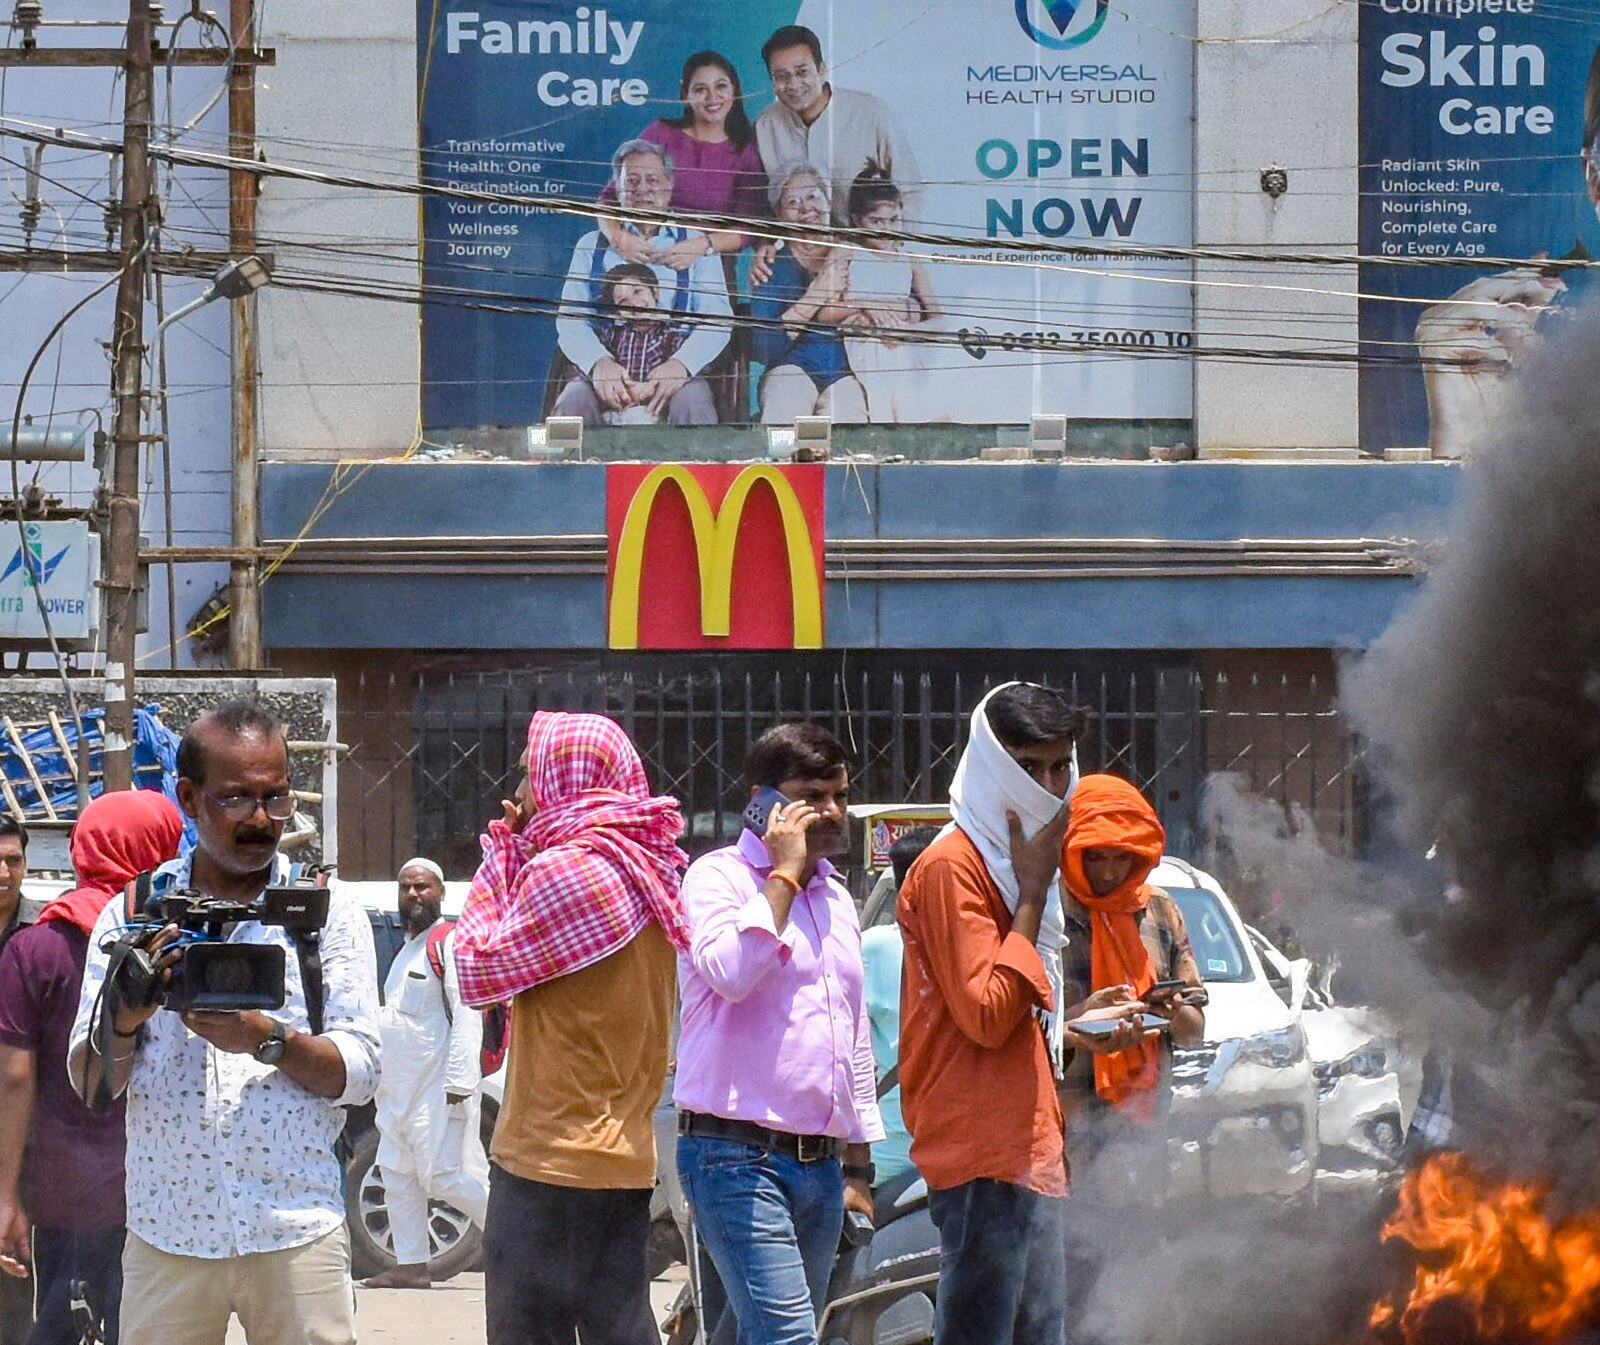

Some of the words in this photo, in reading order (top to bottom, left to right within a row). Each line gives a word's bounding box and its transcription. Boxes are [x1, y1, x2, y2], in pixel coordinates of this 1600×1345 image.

[446, 6, 646, 65] Family
[1380, 26, 1545, 88] Skin
[966, 64, 1158, 82] MEDIVERSAL
[537, 71, 649, 107] Care
[966, 90, 1063, 105] HEALTH
[1070, 89, 1156, 104] STUDIO
[1438, 98, 1555, 135] Care
[447, 139, 566, 153] Transformative
[447, 160, 505, 174] Health:
[508, 160, 542, 173] One
[975, 138, 1150, 180] OPEN
[1381, 158, 1442, 172] Radiant
[1446, 158, 1481, 172] Skin
[447, 180, 540, 194] Destination
[543, 180, 565, 193] for
[1381, 179, 1460, 193] Unlocked:
[1463, 179, 1505, 194] Pure,
[447, 201, 483, 214] Your
[1381, 199, 1473, 216] Nourishing,
[985, 198, 1143, 239] NOW
[447, 222, 520, 236] Wellness
[1380, 220, 1458, 237] Complete
[1461, 220, 1498, 234] Care
[446, 242, 513, 259] Journey
[1381, 240, 1403, 255] for
[1407, 241, 1451, 257] Every
[1454, 241, 1486, 257] Age
[996, 252, 1067, 264] Experience:
